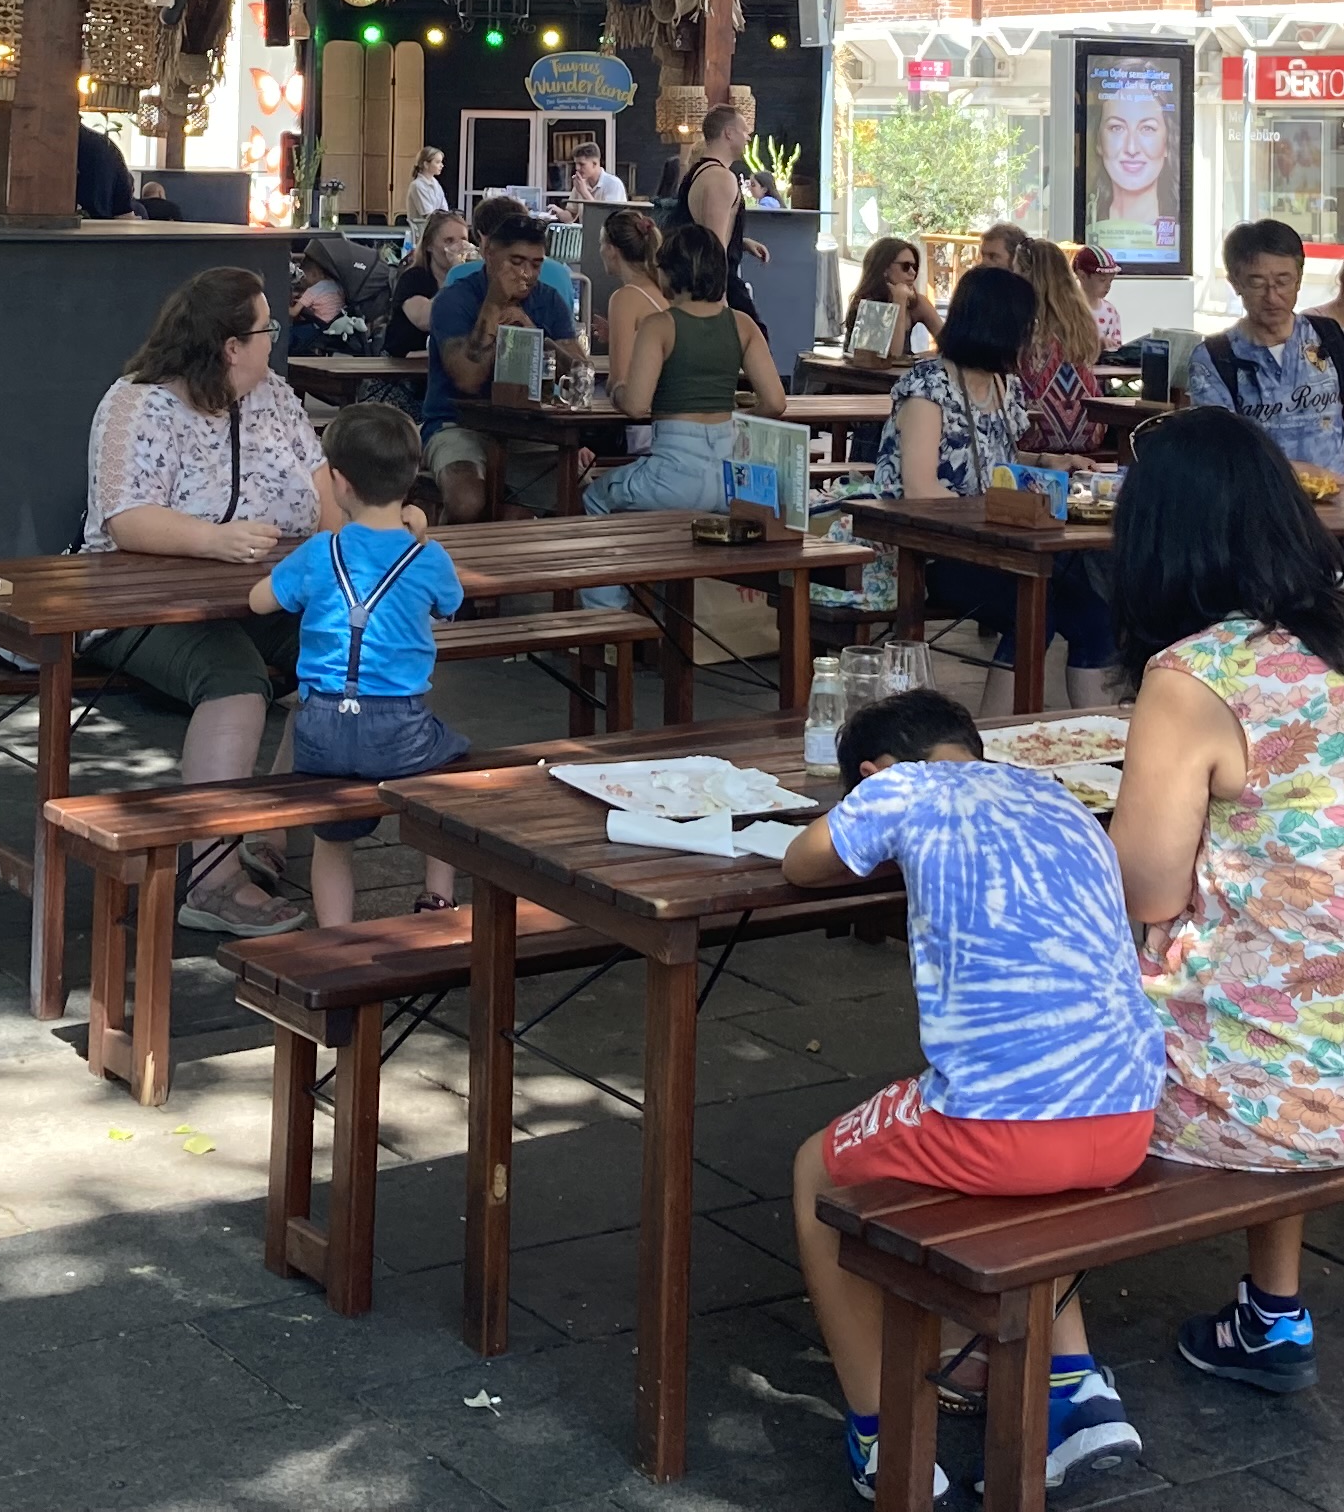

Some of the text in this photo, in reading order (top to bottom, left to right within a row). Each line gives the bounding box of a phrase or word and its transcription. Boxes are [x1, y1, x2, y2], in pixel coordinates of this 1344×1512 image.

[550, 58, 601, 79] Taunus
[525, 72, 638, 106] Wunderland
[1228, 129, 1281, 142] Reebüro
[1285, 384, 1341, 414] Roya
